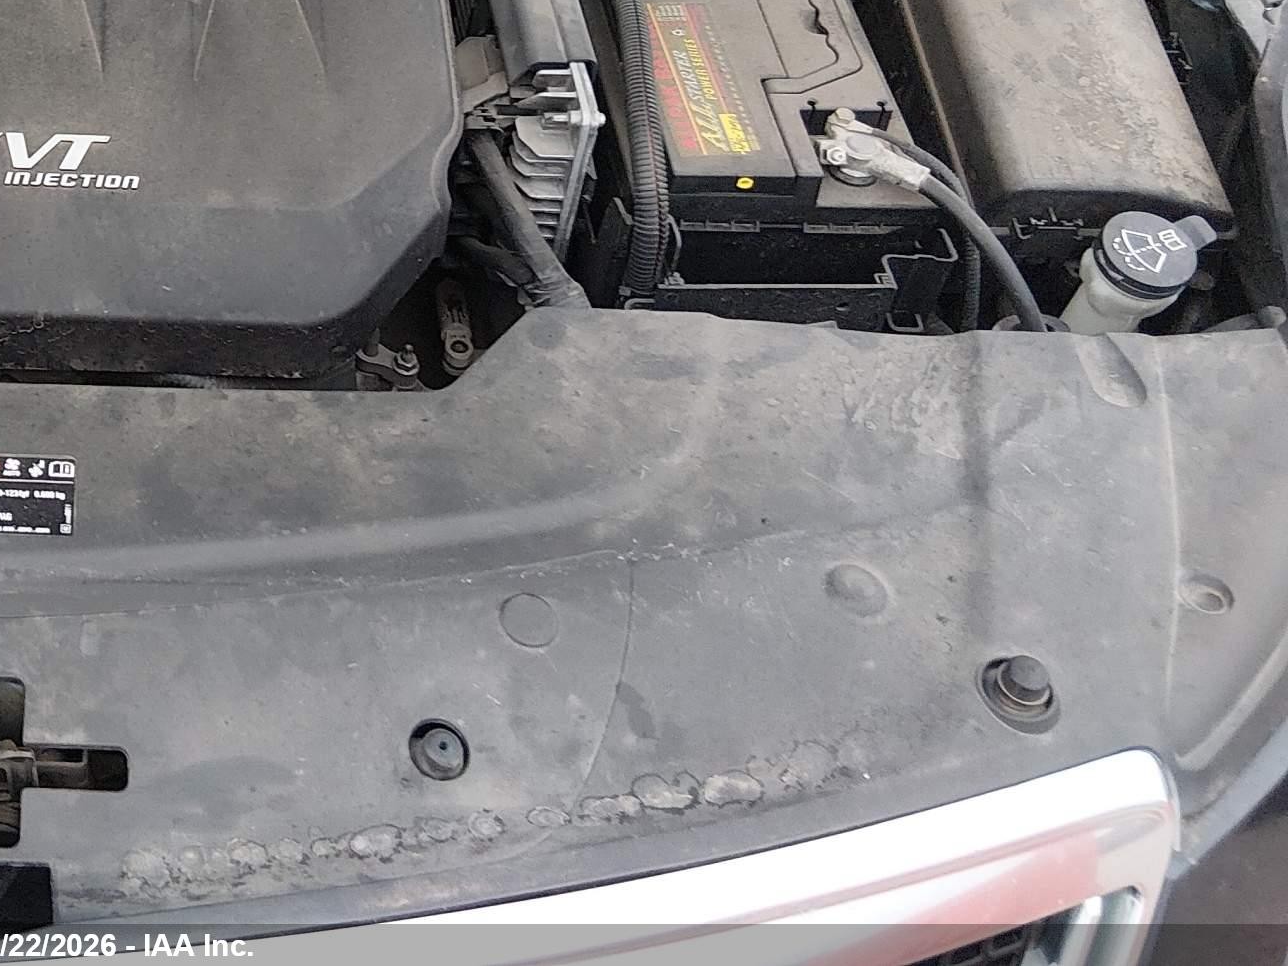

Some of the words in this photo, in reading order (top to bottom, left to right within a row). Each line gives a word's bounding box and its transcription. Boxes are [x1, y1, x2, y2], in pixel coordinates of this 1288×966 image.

[683, 38, 705, 68] SERIES
[696, 70, 718, 101] POWER
[4, 171, 140, 190] INJECTION
